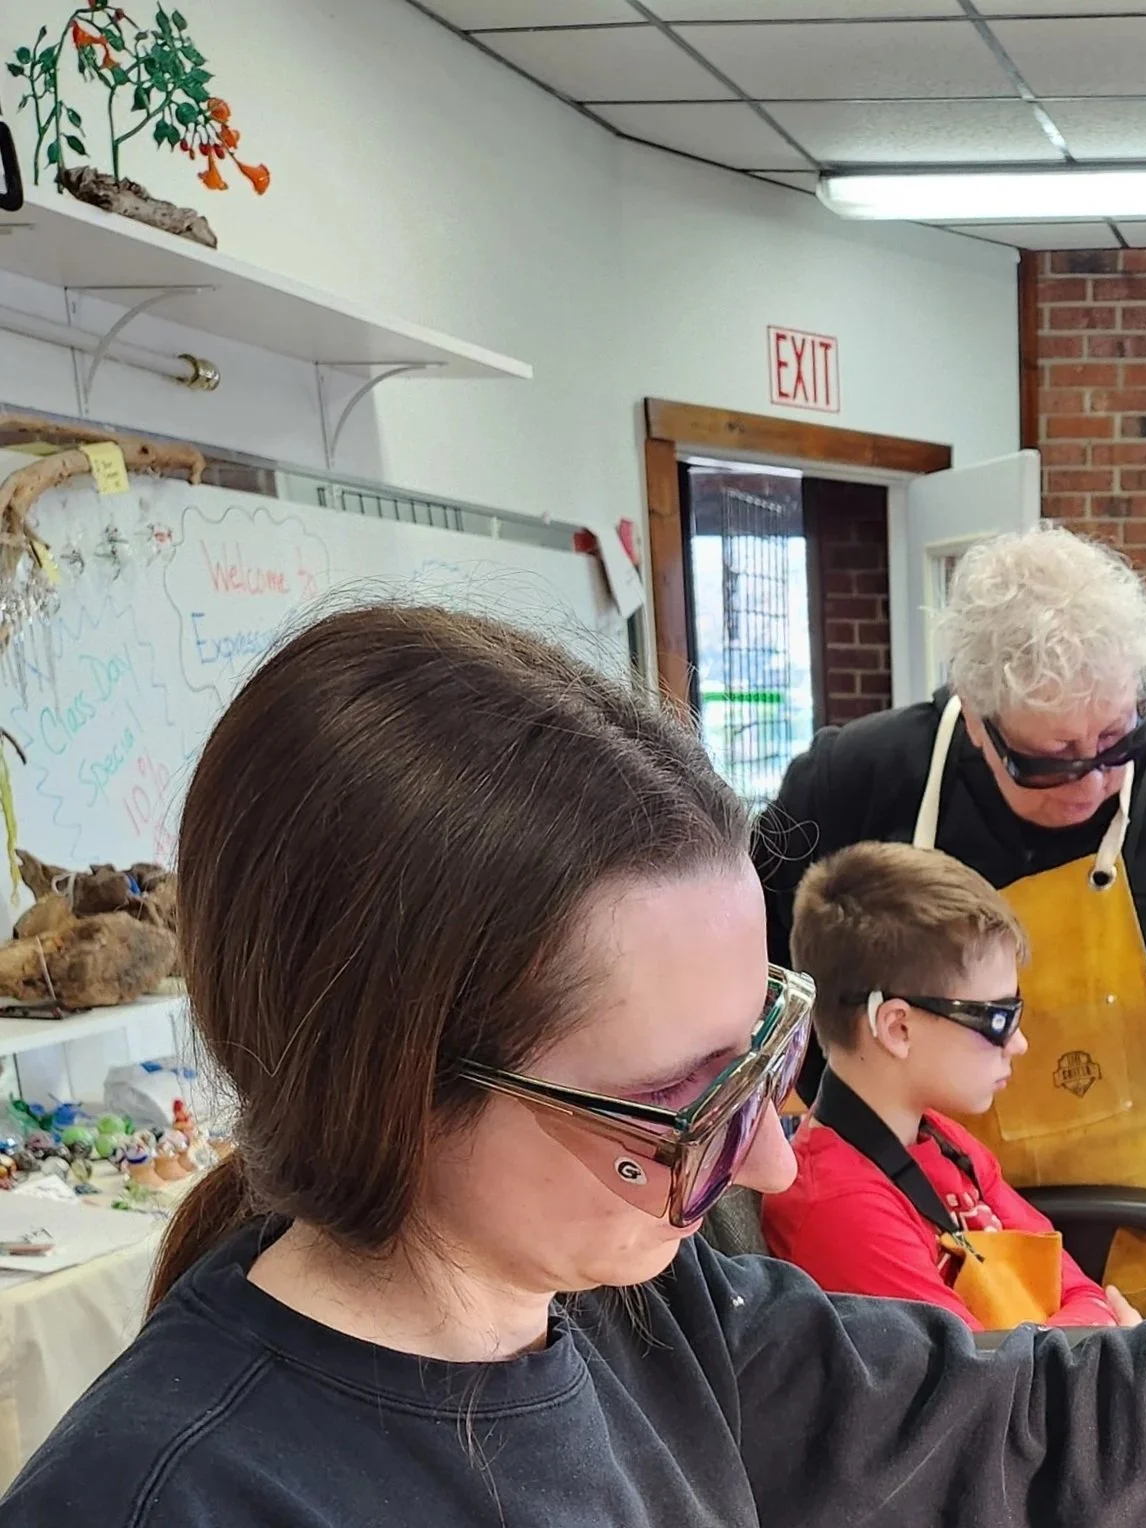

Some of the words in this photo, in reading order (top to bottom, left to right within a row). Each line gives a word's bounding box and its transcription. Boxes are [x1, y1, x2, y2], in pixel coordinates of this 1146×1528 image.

[776, 333, 831, 405] EXIT
[200, 540, 290, 595] Welcome
[39, 691, 97, 756] Class
